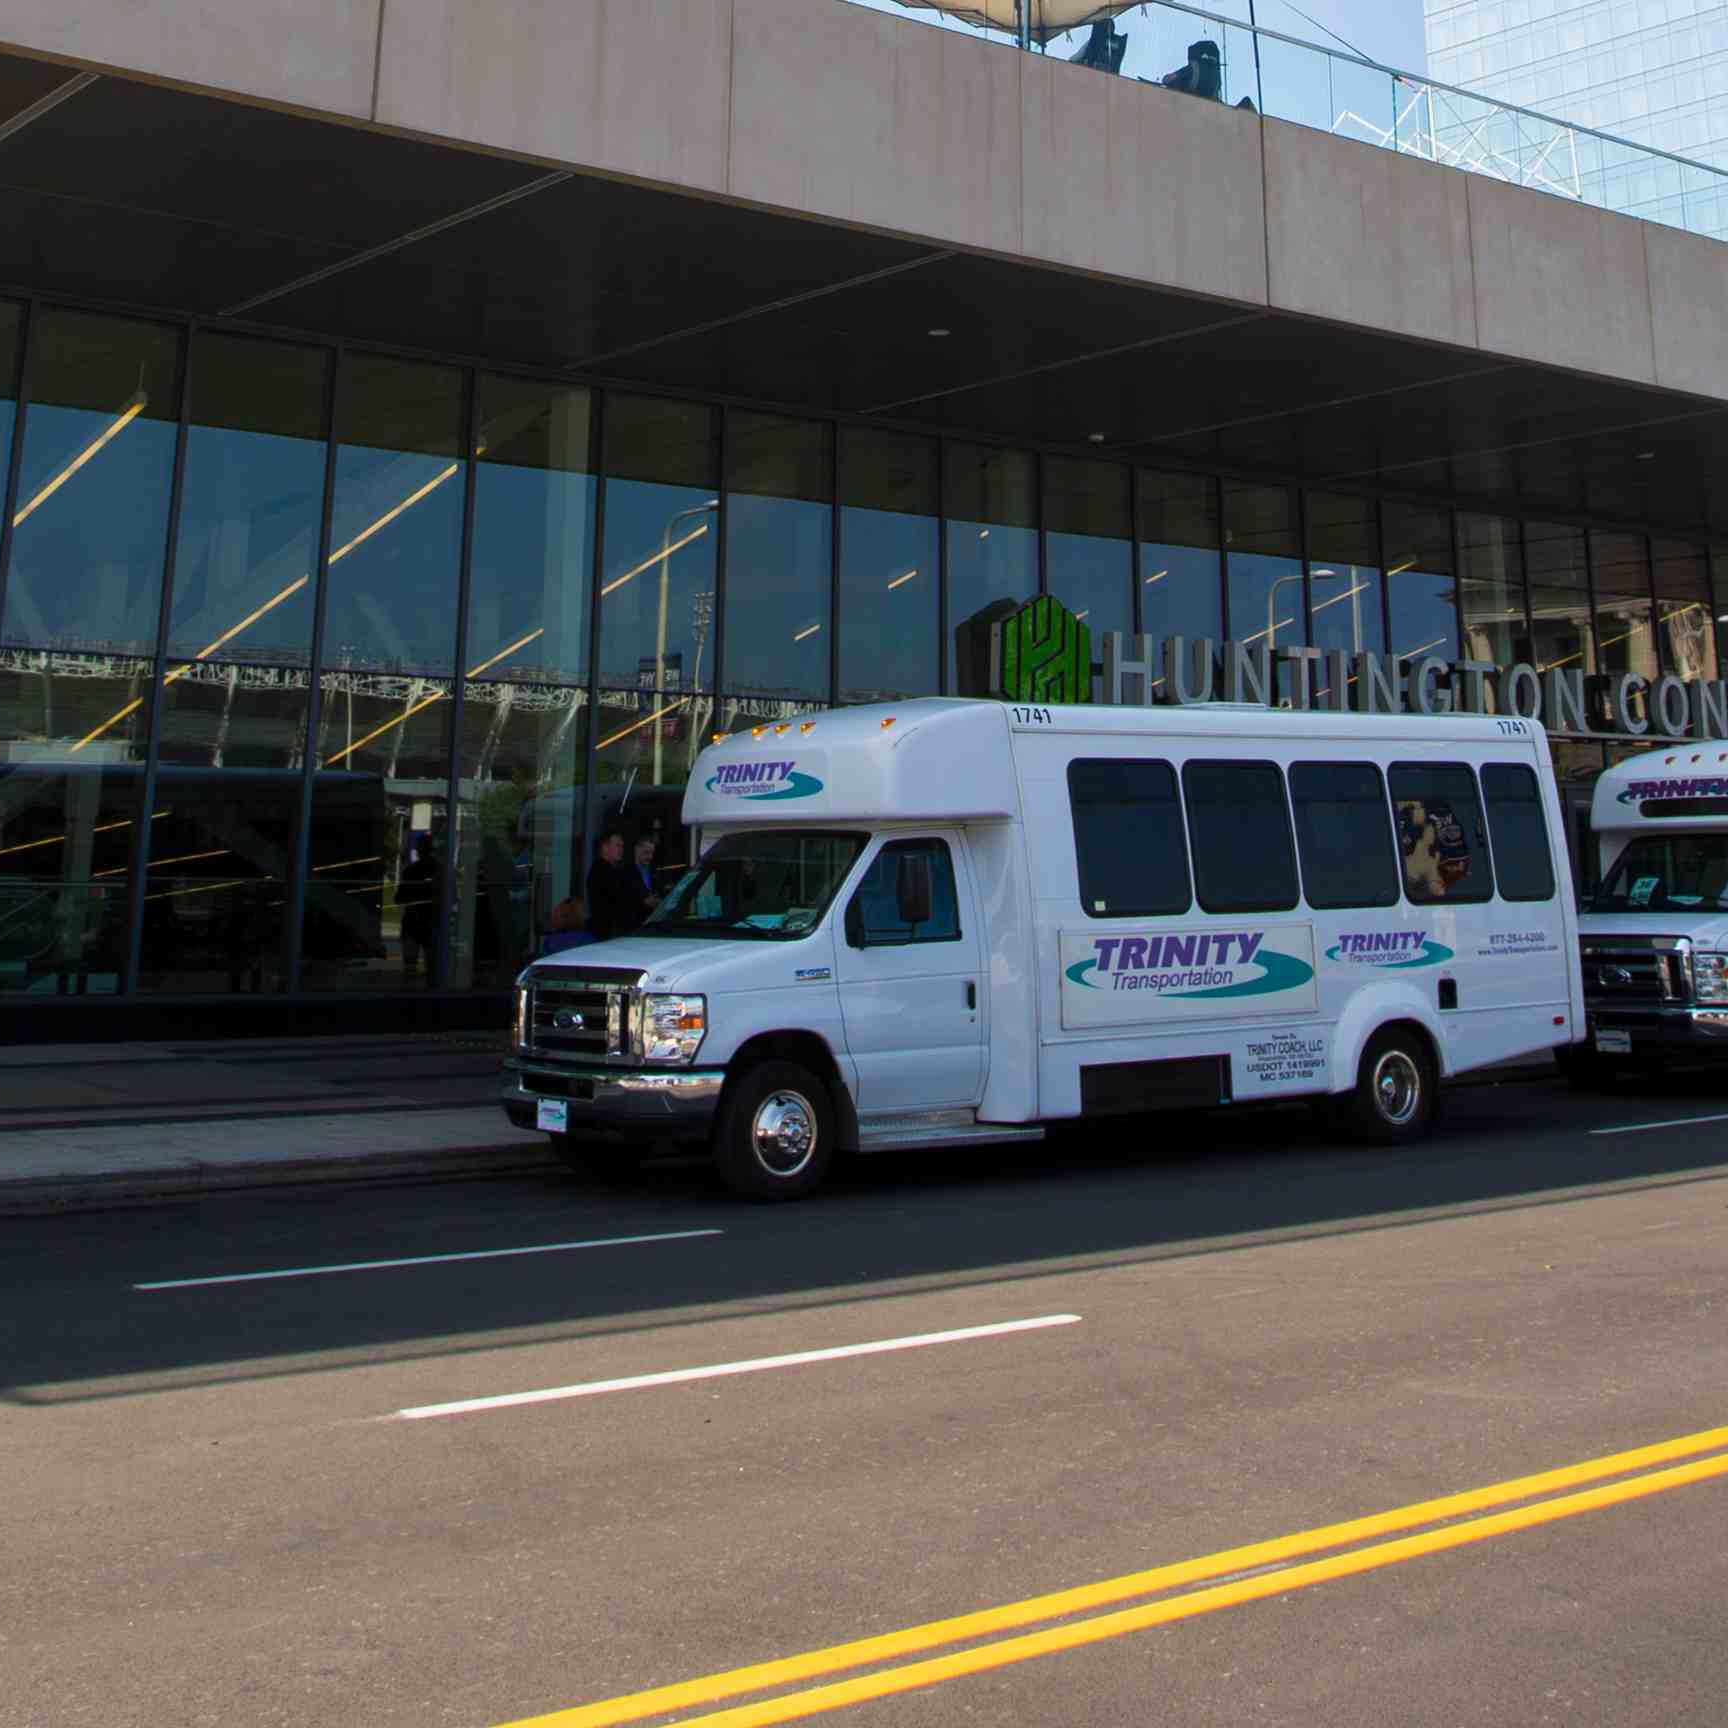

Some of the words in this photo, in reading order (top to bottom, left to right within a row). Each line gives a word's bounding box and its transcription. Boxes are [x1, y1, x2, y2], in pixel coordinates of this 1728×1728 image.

[1103, 631, 1586, 733] HUNTINGTON
[1012, 707, 1052, 725] 1741
[1497, 720, 1527, 735] 1741
[715, 761, 796, 785] TRINITY
[720, 781, 775, 796] Transportation
[1338, 931, 1427, 953] TRINITY
[1093, 932, 1265, 972] TRINITY
[1347, 950, 1412, 965] Transportation
[1111, 967, 1233, 992] Transportation
[1246, 1041, 1277, 1057] TRINITY
[1308, 1039, 1323, 1052] LLC
[1247, 1061, 1283, 1073] USDOT
[1259, 1072, 1276, 1081] MC
